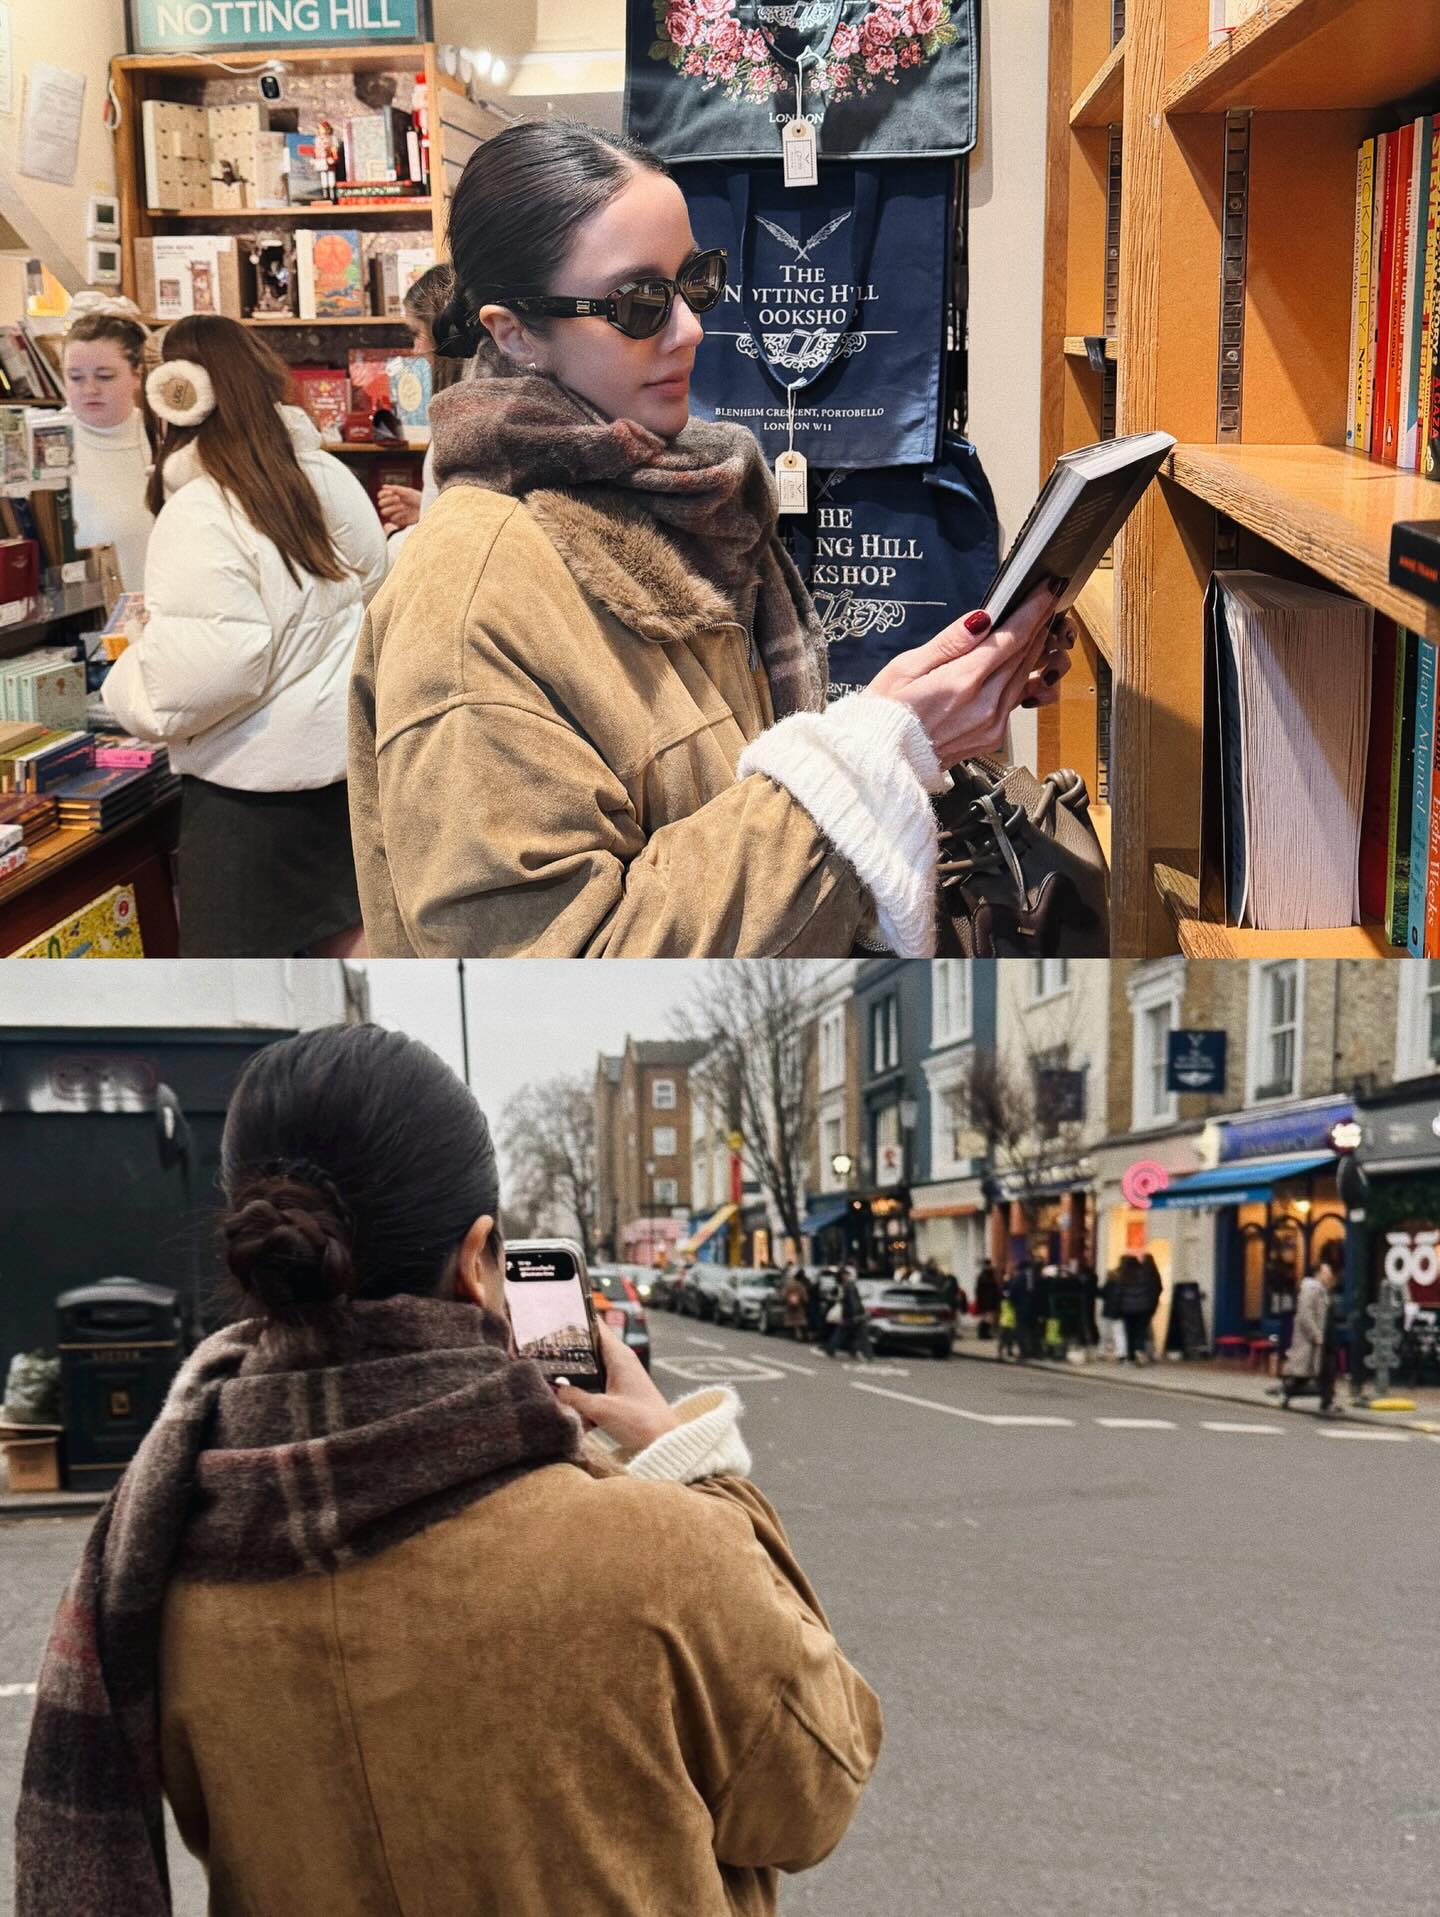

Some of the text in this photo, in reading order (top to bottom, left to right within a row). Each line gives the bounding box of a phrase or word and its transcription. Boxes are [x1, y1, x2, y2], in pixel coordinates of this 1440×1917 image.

[157, 0, 401, 36] NOTTING HILL
[779, 265, 826, 283] THE
[1357, 156, 1371, 404] RICK ASTLEY Never
[724, 284, 879, 304] NTTING HLL
[759, 309, 857, 325] OOKSHO
[715, 407, 884, 418] BLENHEIM CRESCENT, PORTOBELLO
[812, 422, 832, 432] W11
[817, 508, 853, 528] HE
[859, 533, 924, 560] HILL
[812, 564, 897, 586] KSHOP
[1416, 642, 1433, 814] Hilary Mantel
[1428, 797, 1440, 926] Eight Weeks
